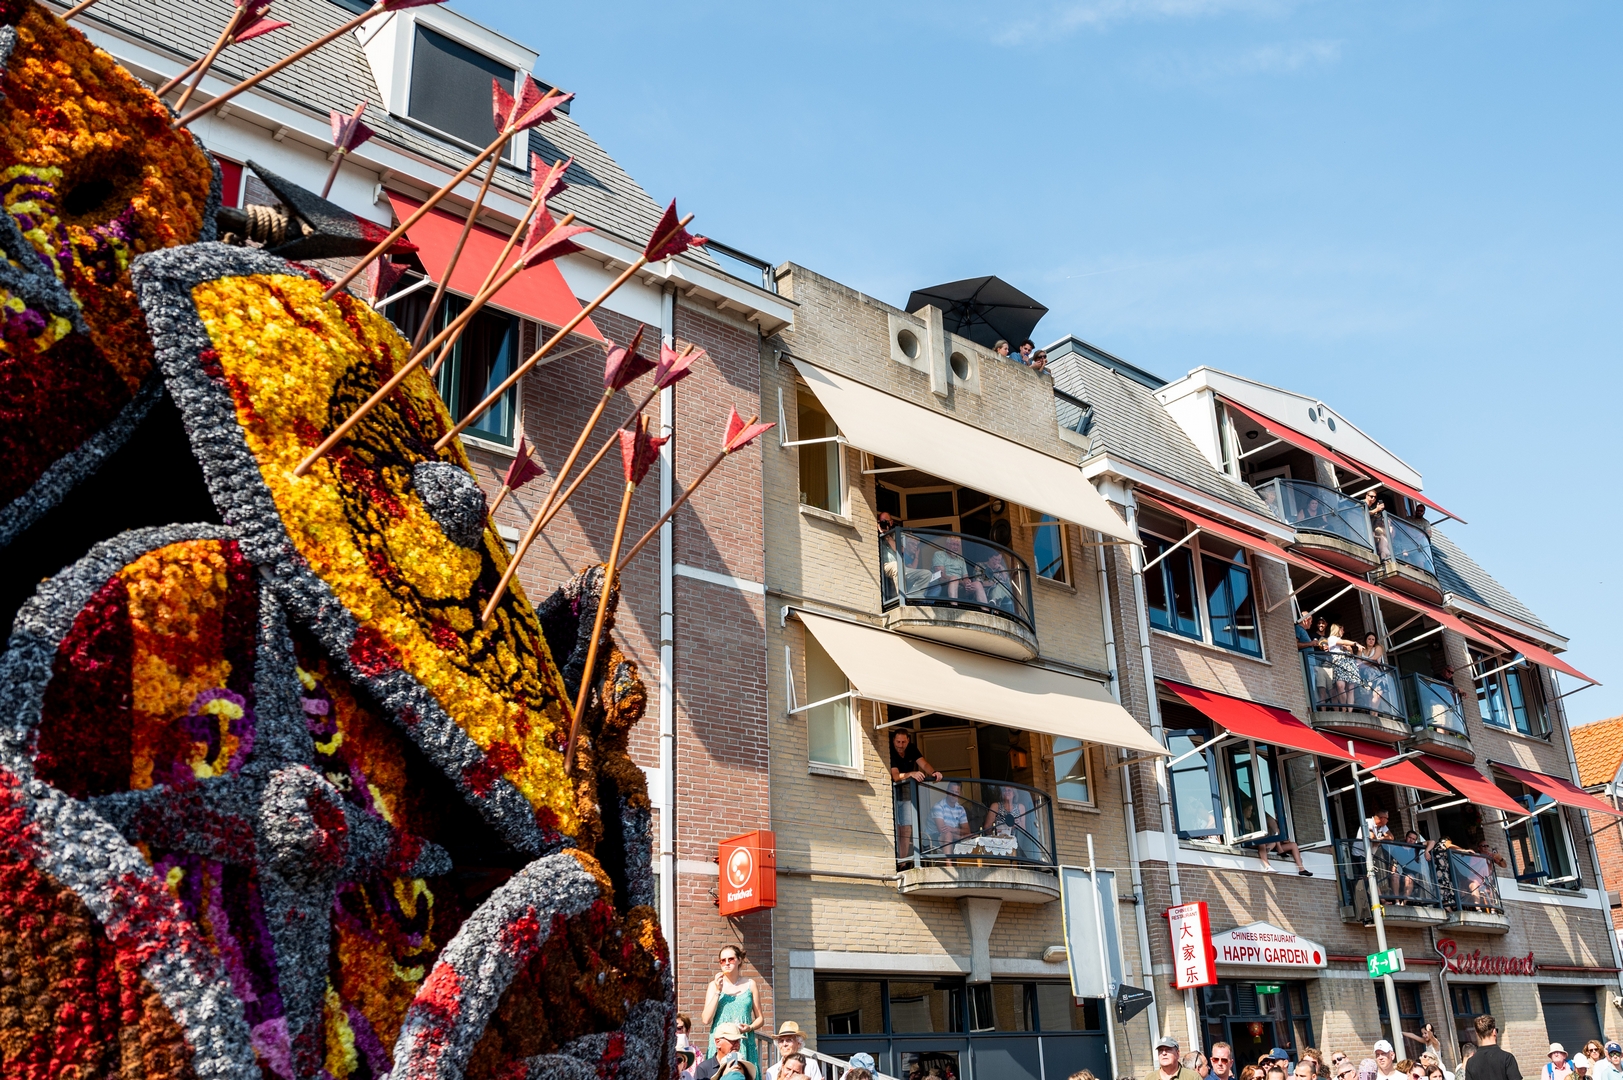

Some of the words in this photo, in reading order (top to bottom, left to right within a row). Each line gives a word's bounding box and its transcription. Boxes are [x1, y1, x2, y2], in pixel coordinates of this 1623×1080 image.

[1171, 911, 1198, 921] RESTAURANT
[1231, 931, 1258, 941] CHINEES
[1258, 933, 1297, 944] RESTAURANT
[1180, 922, 1199, 983] 大家乐
[1223, 945, 1261, 963] HAPPY
[1264, 947, 1310, 965] GARDEN
[1437, 938, 1534, 976] Restaurant
